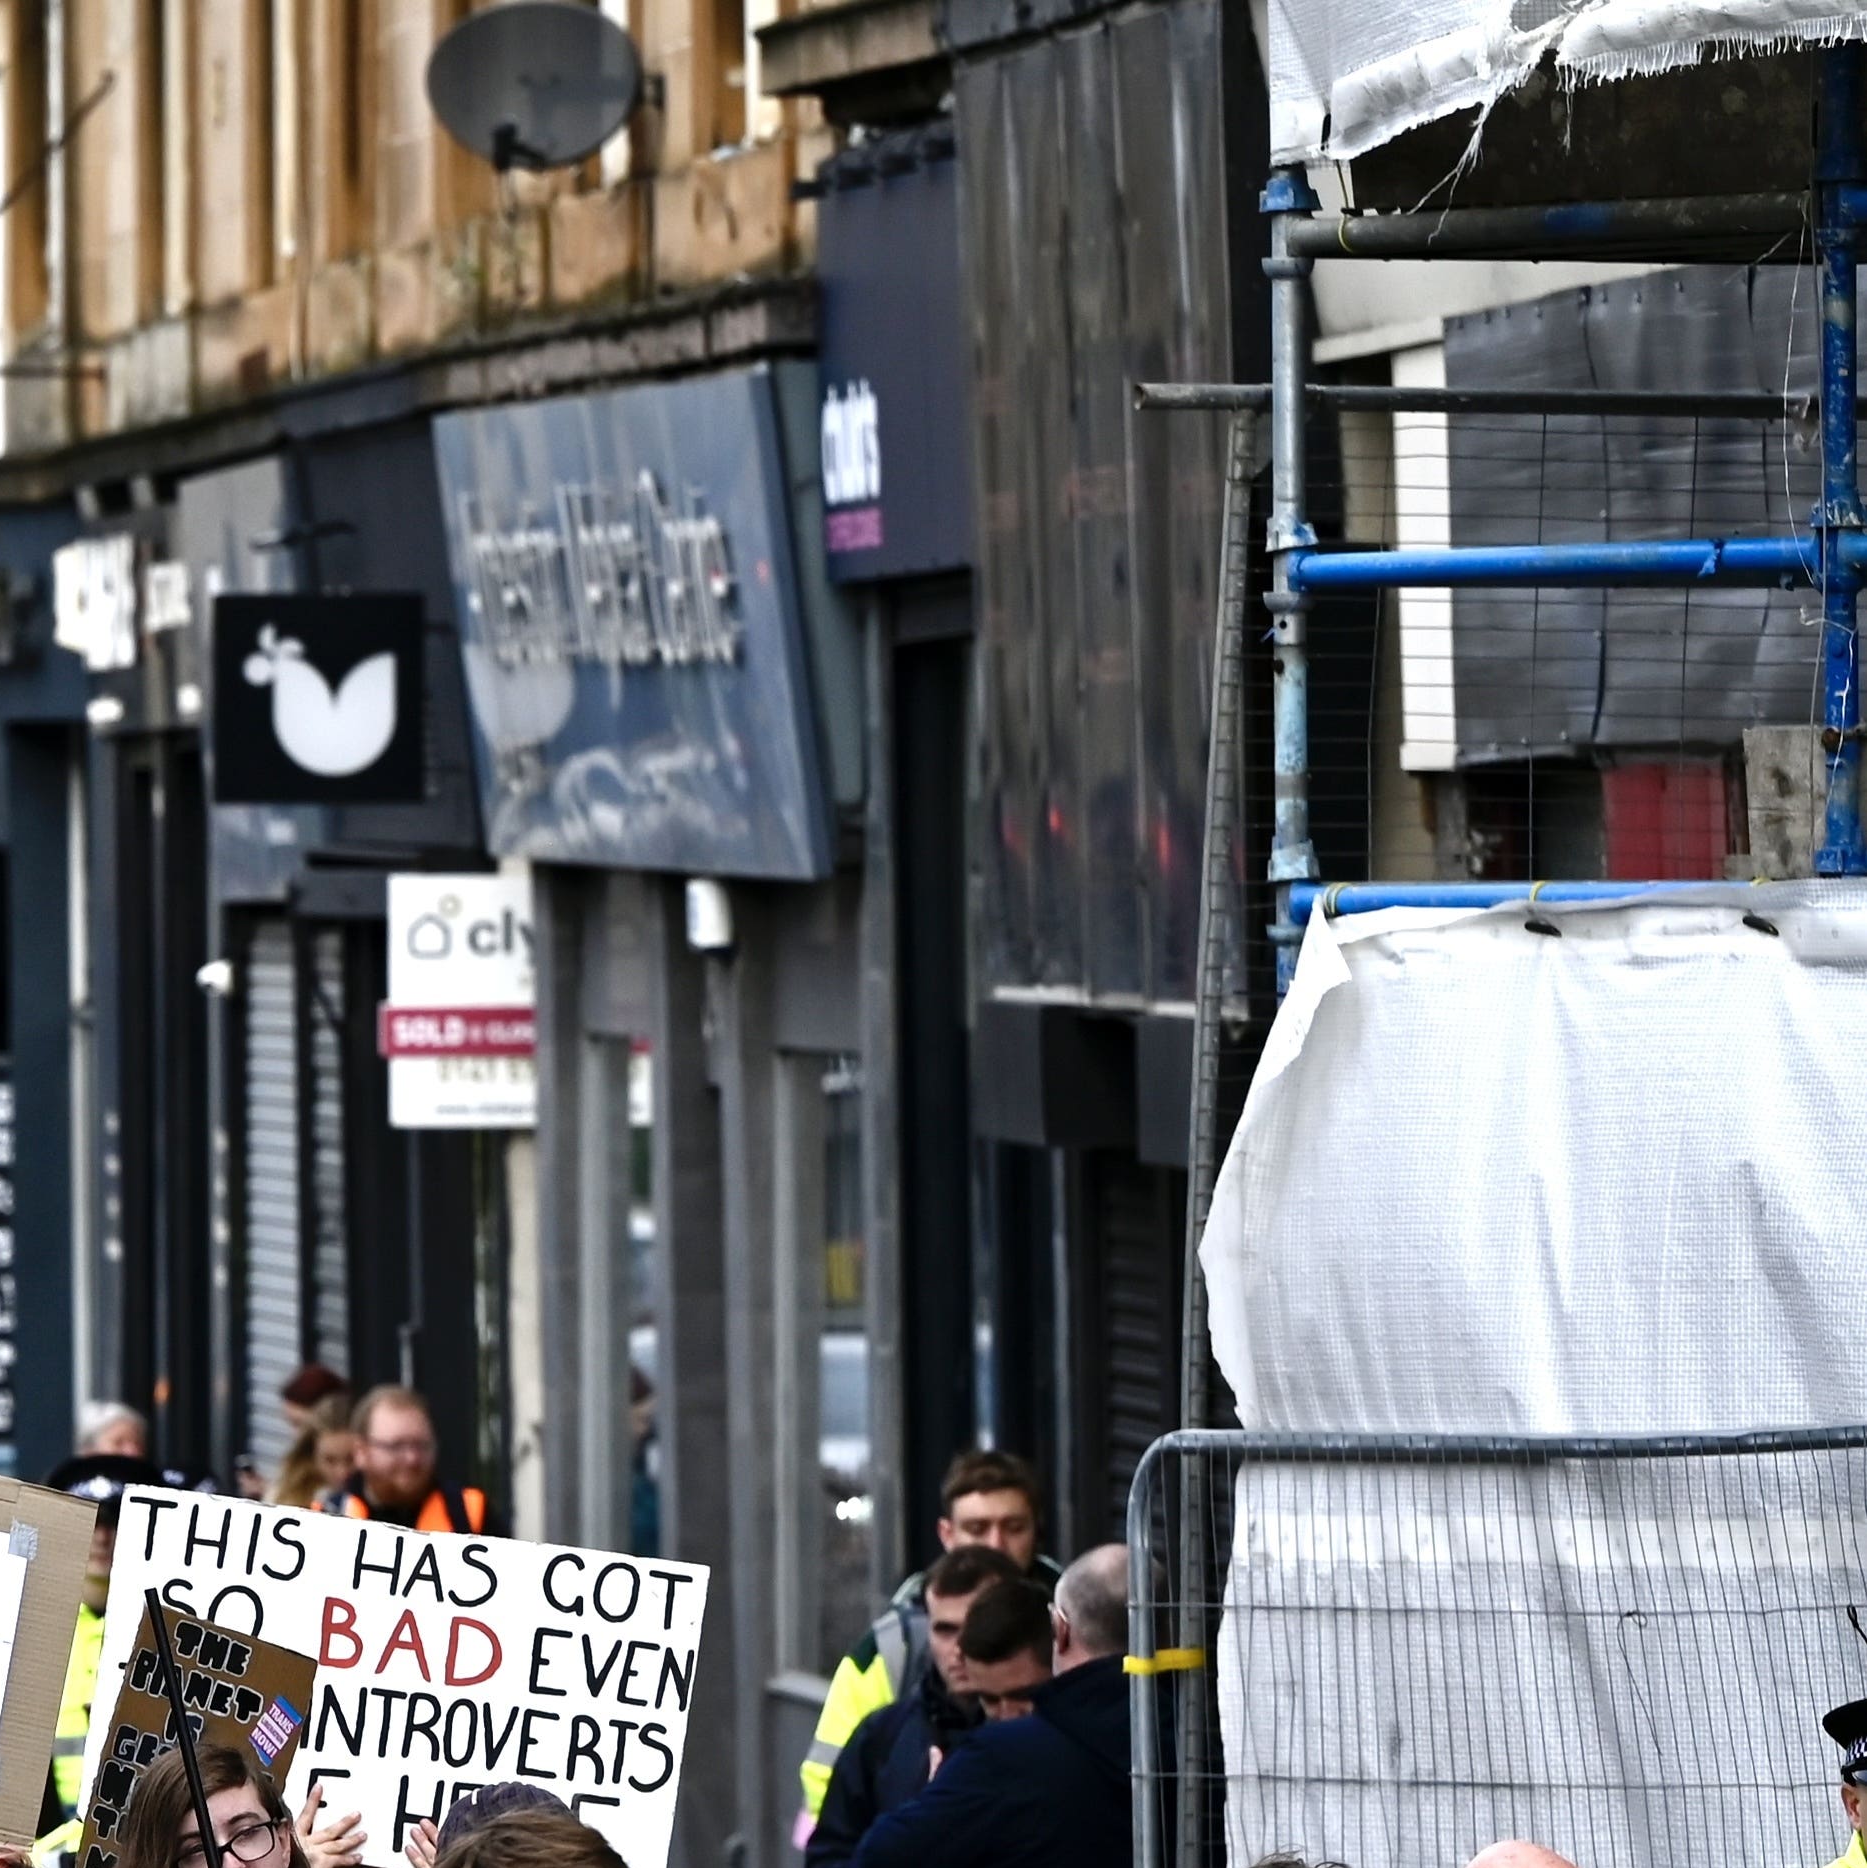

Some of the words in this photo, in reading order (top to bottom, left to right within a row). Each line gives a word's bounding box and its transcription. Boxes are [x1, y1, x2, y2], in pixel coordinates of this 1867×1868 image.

[129, 1497, 306, 1580] THIS
[353, 1528, 498, 1607] HAS
[543, 1554, 693, 1630] GOT
[174, 1620, 253, 1677] THE
[319, 1596, 503, 1687] BAD
[529, 1628, 695, 1711] EVEN
[250, 1726, 278, 1759] NOW!
[268, 1702, 294, 1735] TRANS
[299, 1684, 675, 1793] INTROVERTS
